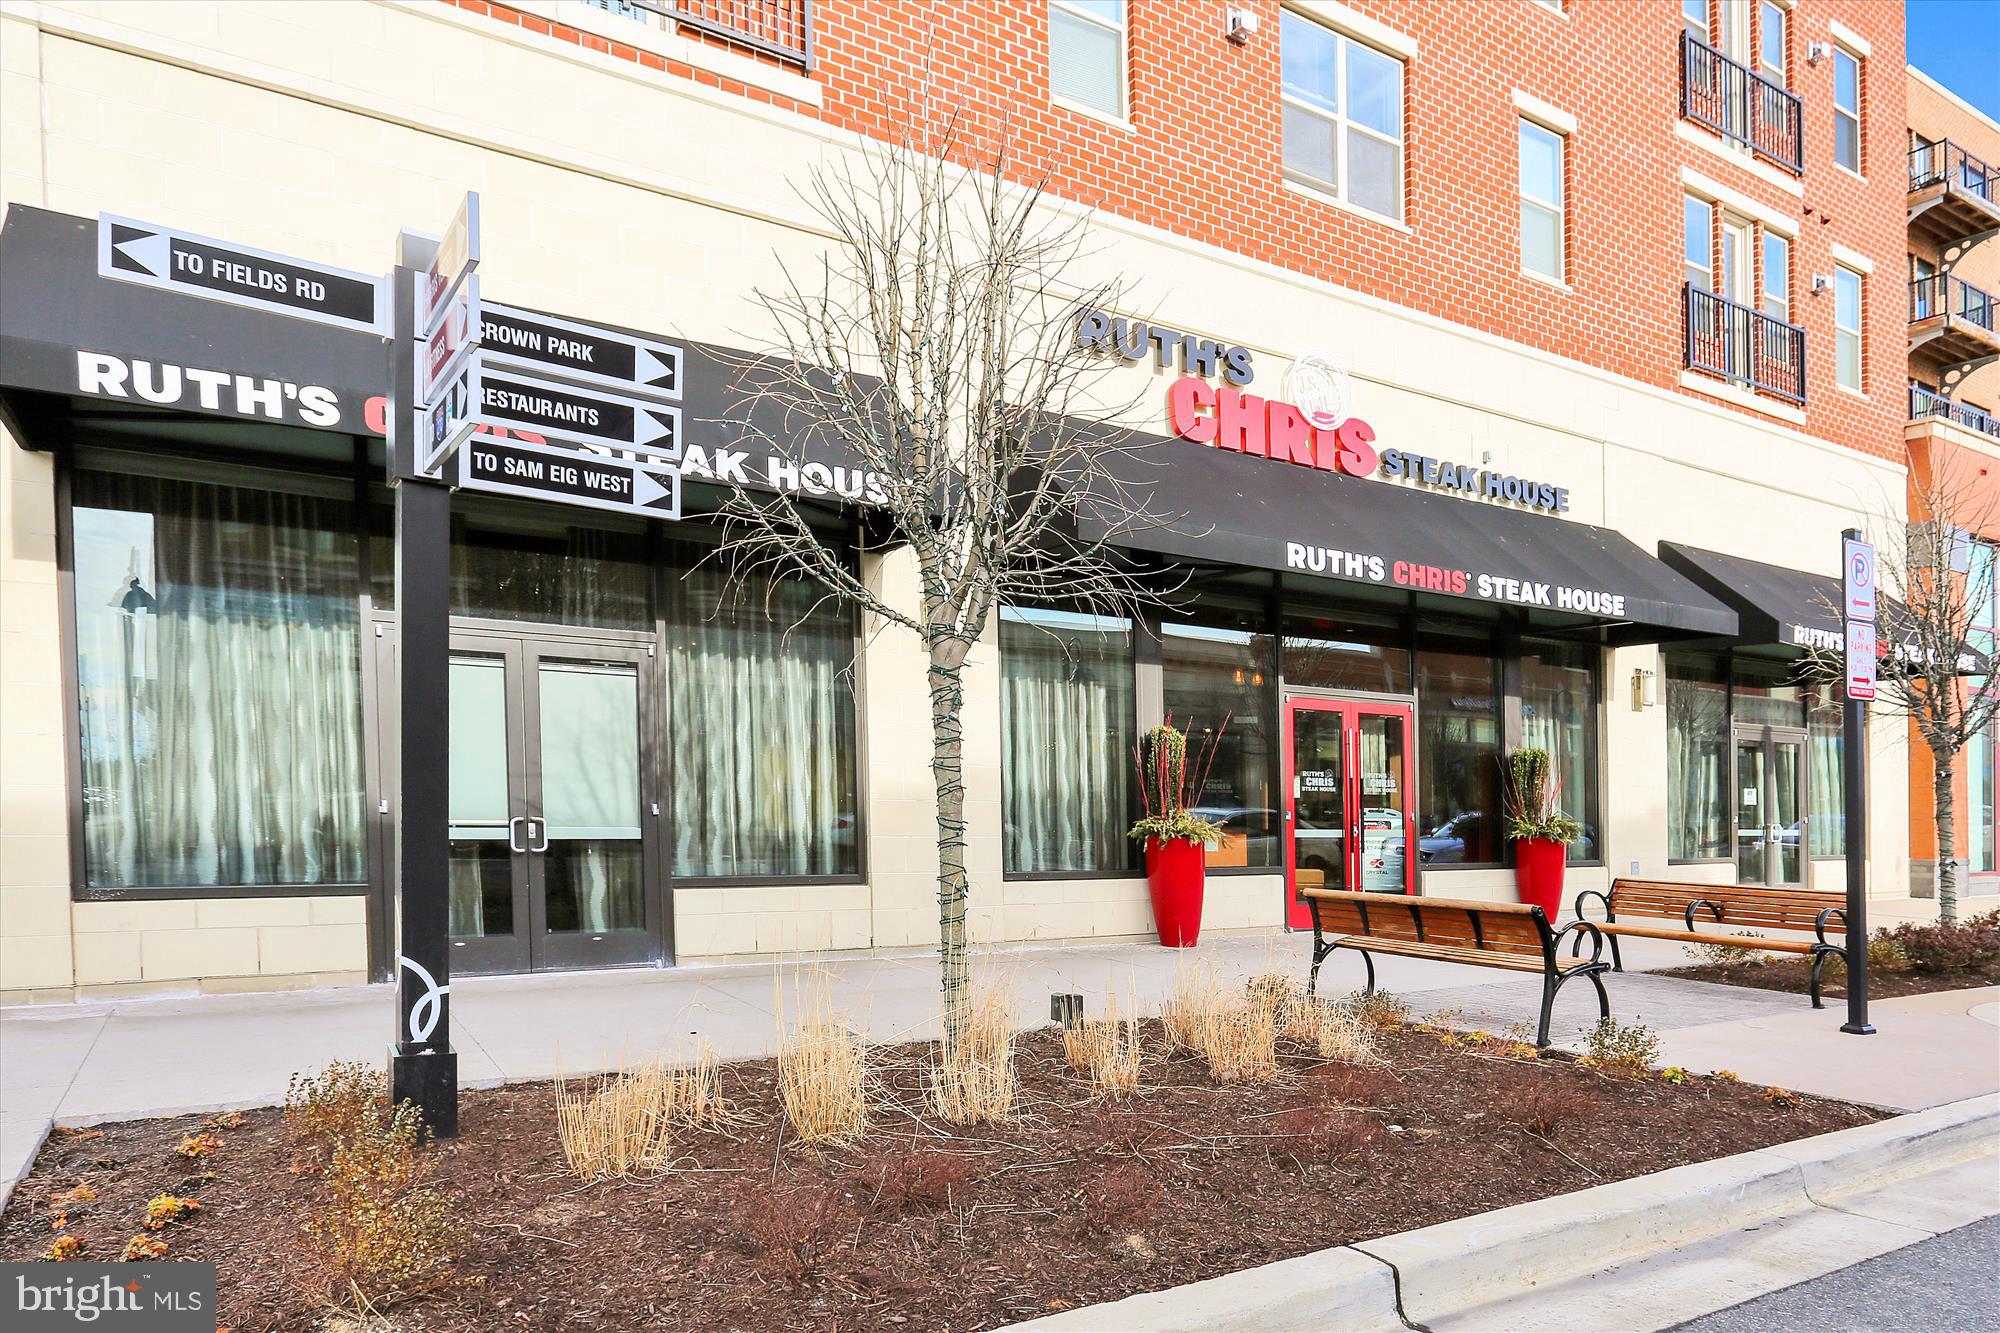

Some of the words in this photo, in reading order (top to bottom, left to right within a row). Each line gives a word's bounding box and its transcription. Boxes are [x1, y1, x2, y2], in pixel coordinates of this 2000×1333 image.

[173, 250, 204, 275] TO
[212, 259, 288, 293] FIELDS
[295, 277, 326, 302] RD
[547, 336, 594, 363] PARK
[1075, 308, 1254, 386] RUTH'S
[77, 350, 341, 427] RUTH'S
[1168, 376, 1377, 478] CHRIS
[473, 451, 497, 472] TO
[504, 457, 544, 480] SAM
[550, 464, 578, 486] EIG
[583, 470, 631, 494] WEST
[767, 456, 912, 509] HOUS
[1379, 447, 1479, 492] STEAK
[1480, 470, 1570, 513] HOUSE
[1286, 541, 1386, 582] RUTH'S
[1477, 573, 1551, 606] STEAK
[1556, 586, 1626, 617] HOUSE
[1793, 625, 1844, 652] RUTH'S
[1305, 777, 1334, 786] CHRIS
